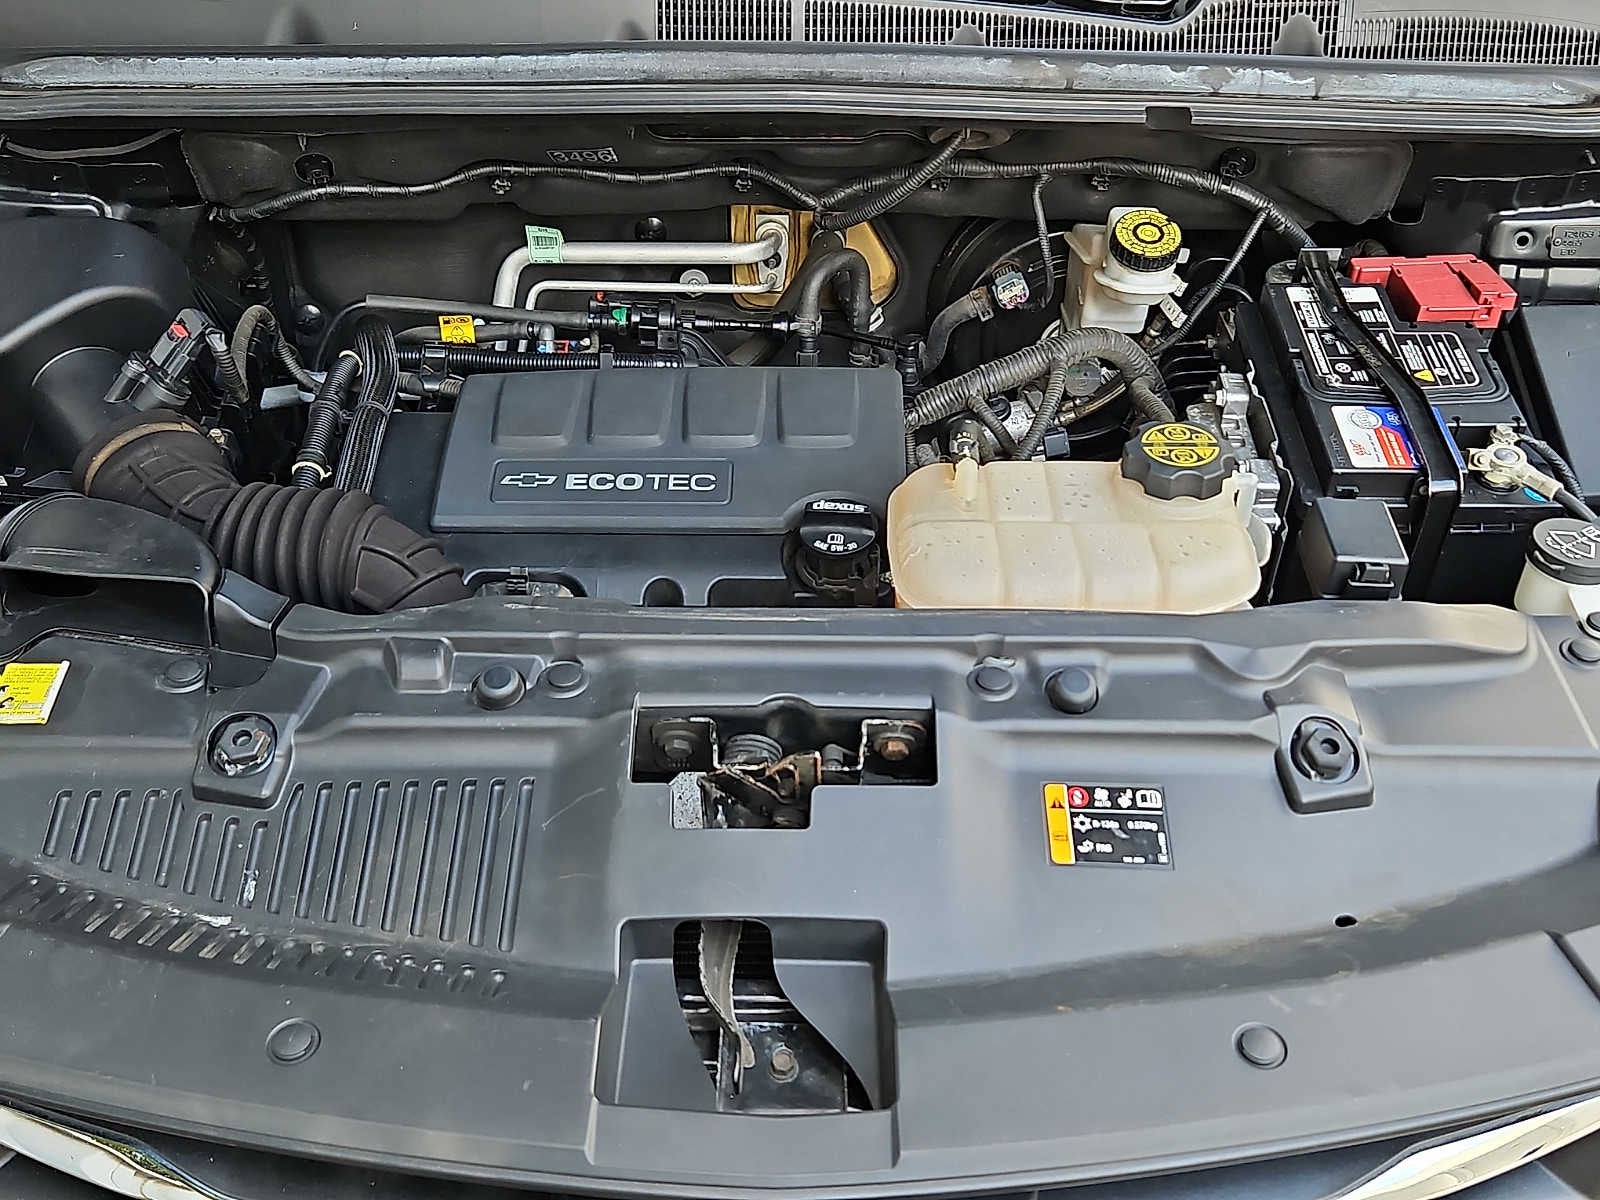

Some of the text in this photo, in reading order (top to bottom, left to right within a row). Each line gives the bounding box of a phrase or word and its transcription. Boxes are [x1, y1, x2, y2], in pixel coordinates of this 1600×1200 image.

[553, 150, 612, 162] 3496
[565, 473, 717, 491] ECOTEC
[812, 500, 867, 512] dexos
